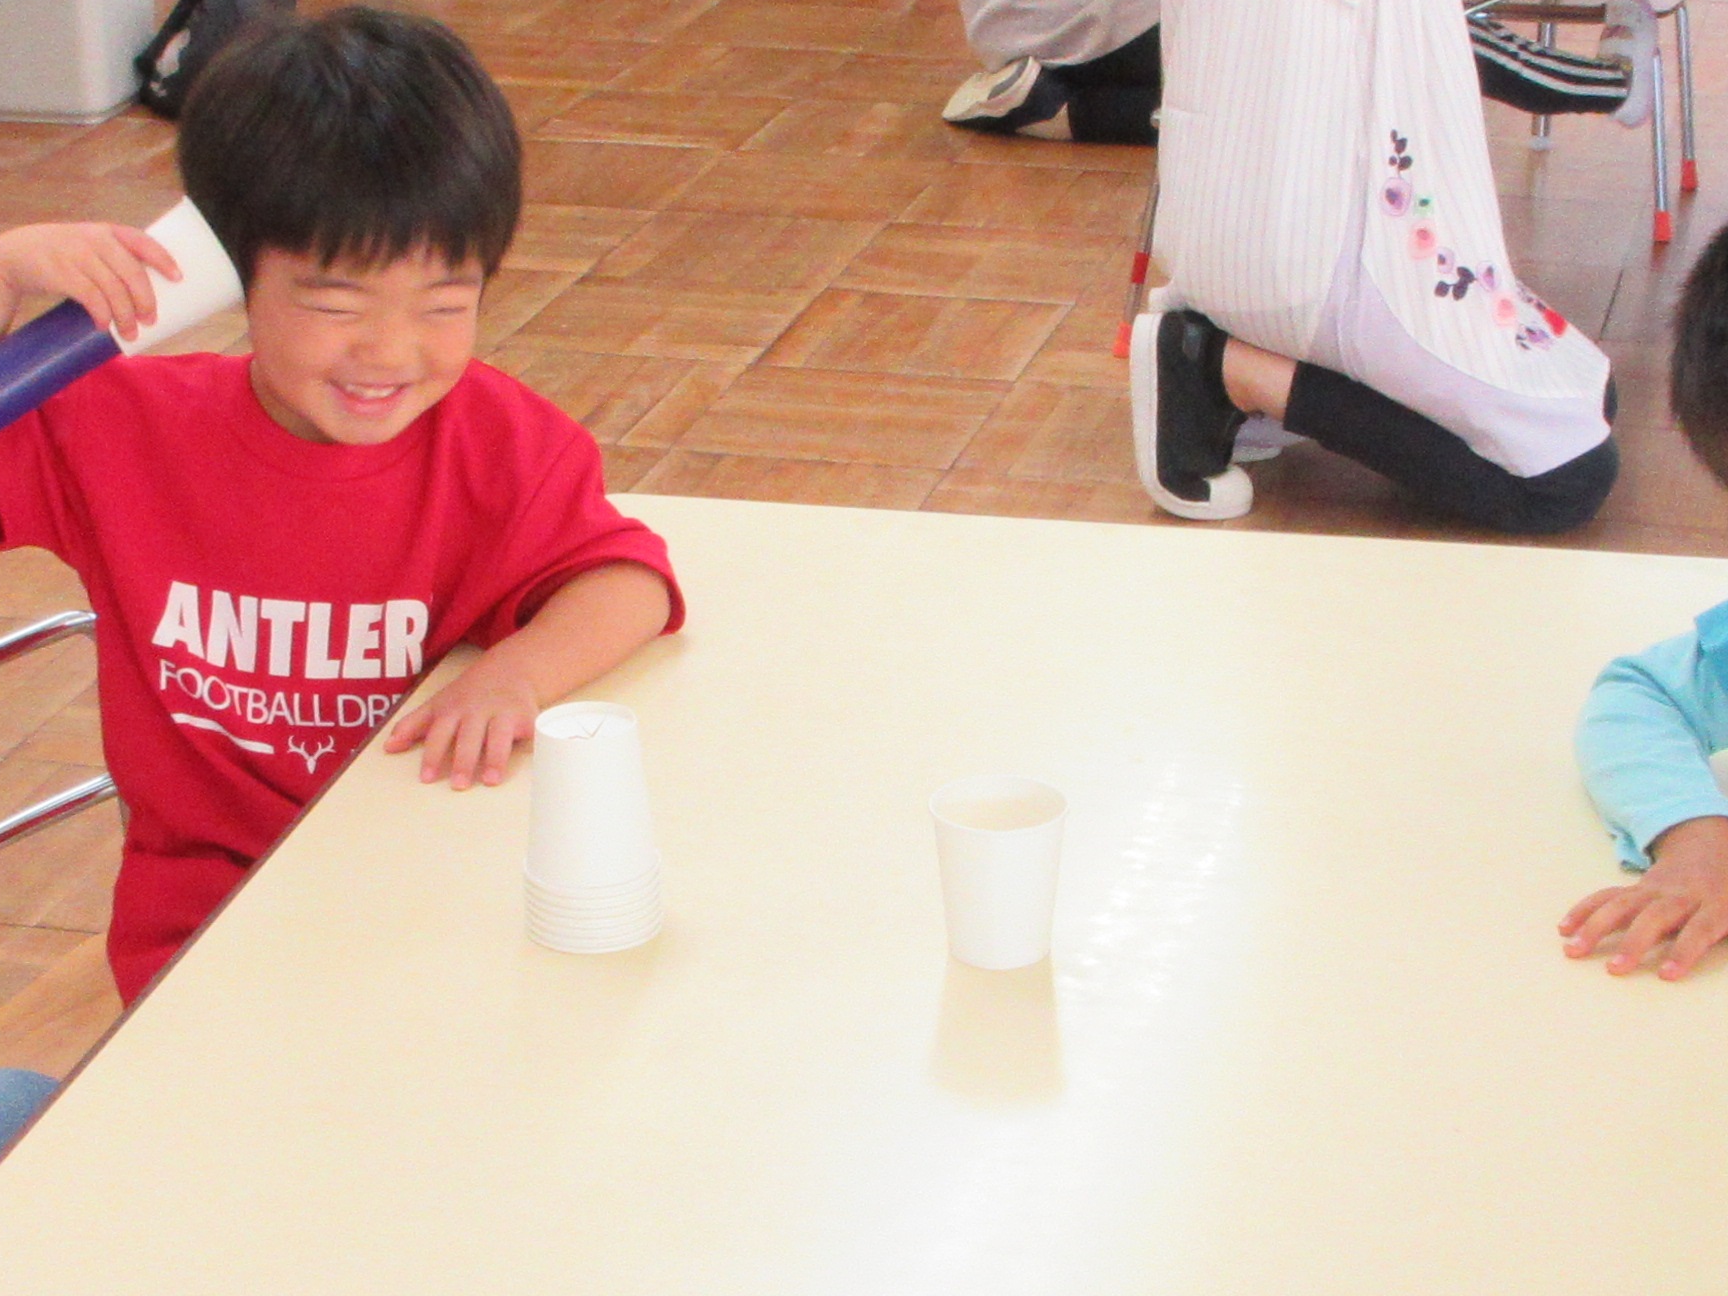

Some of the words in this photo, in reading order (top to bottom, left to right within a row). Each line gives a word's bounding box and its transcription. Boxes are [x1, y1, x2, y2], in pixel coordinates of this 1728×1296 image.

[152, 580, 429, 680] ANTLER
[159, 658, 334, 727] FOOTBALL
[337, 693, 402, 728] DR
